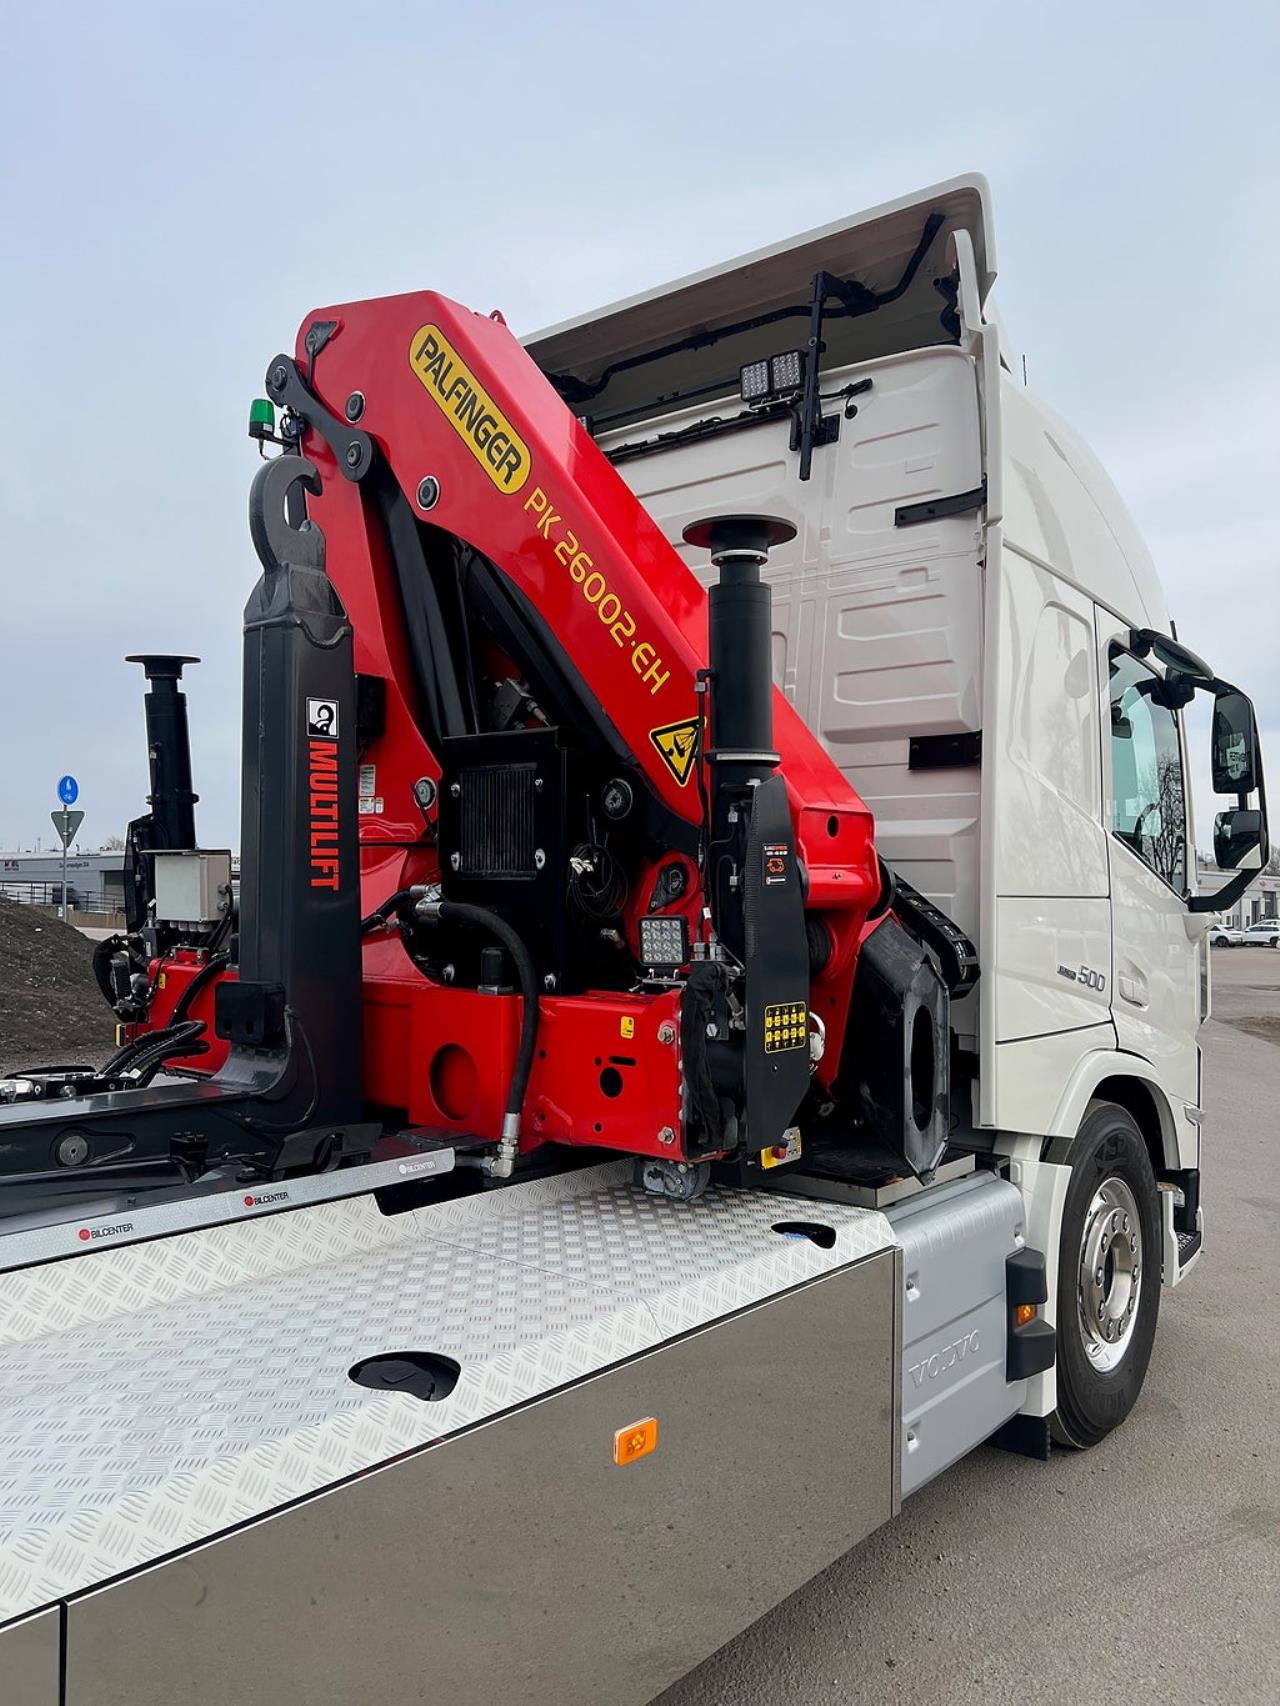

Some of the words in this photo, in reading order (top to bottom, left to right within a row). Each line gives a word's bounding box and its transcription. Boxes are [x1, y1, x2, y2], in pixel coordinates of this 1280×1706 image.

[415, 333, 522, 485] PALFINGER
[523, 486, 562, 540] PK
[309, 741, 340, 891] MULTILIFT
[1077, 965, 1106, 992] 500
[254, 1191, 290, 1206] BILCENTER
[91, 1222, 134, 1239] BILCENTER
[908, 1329, 980, 1389] VOLVO
